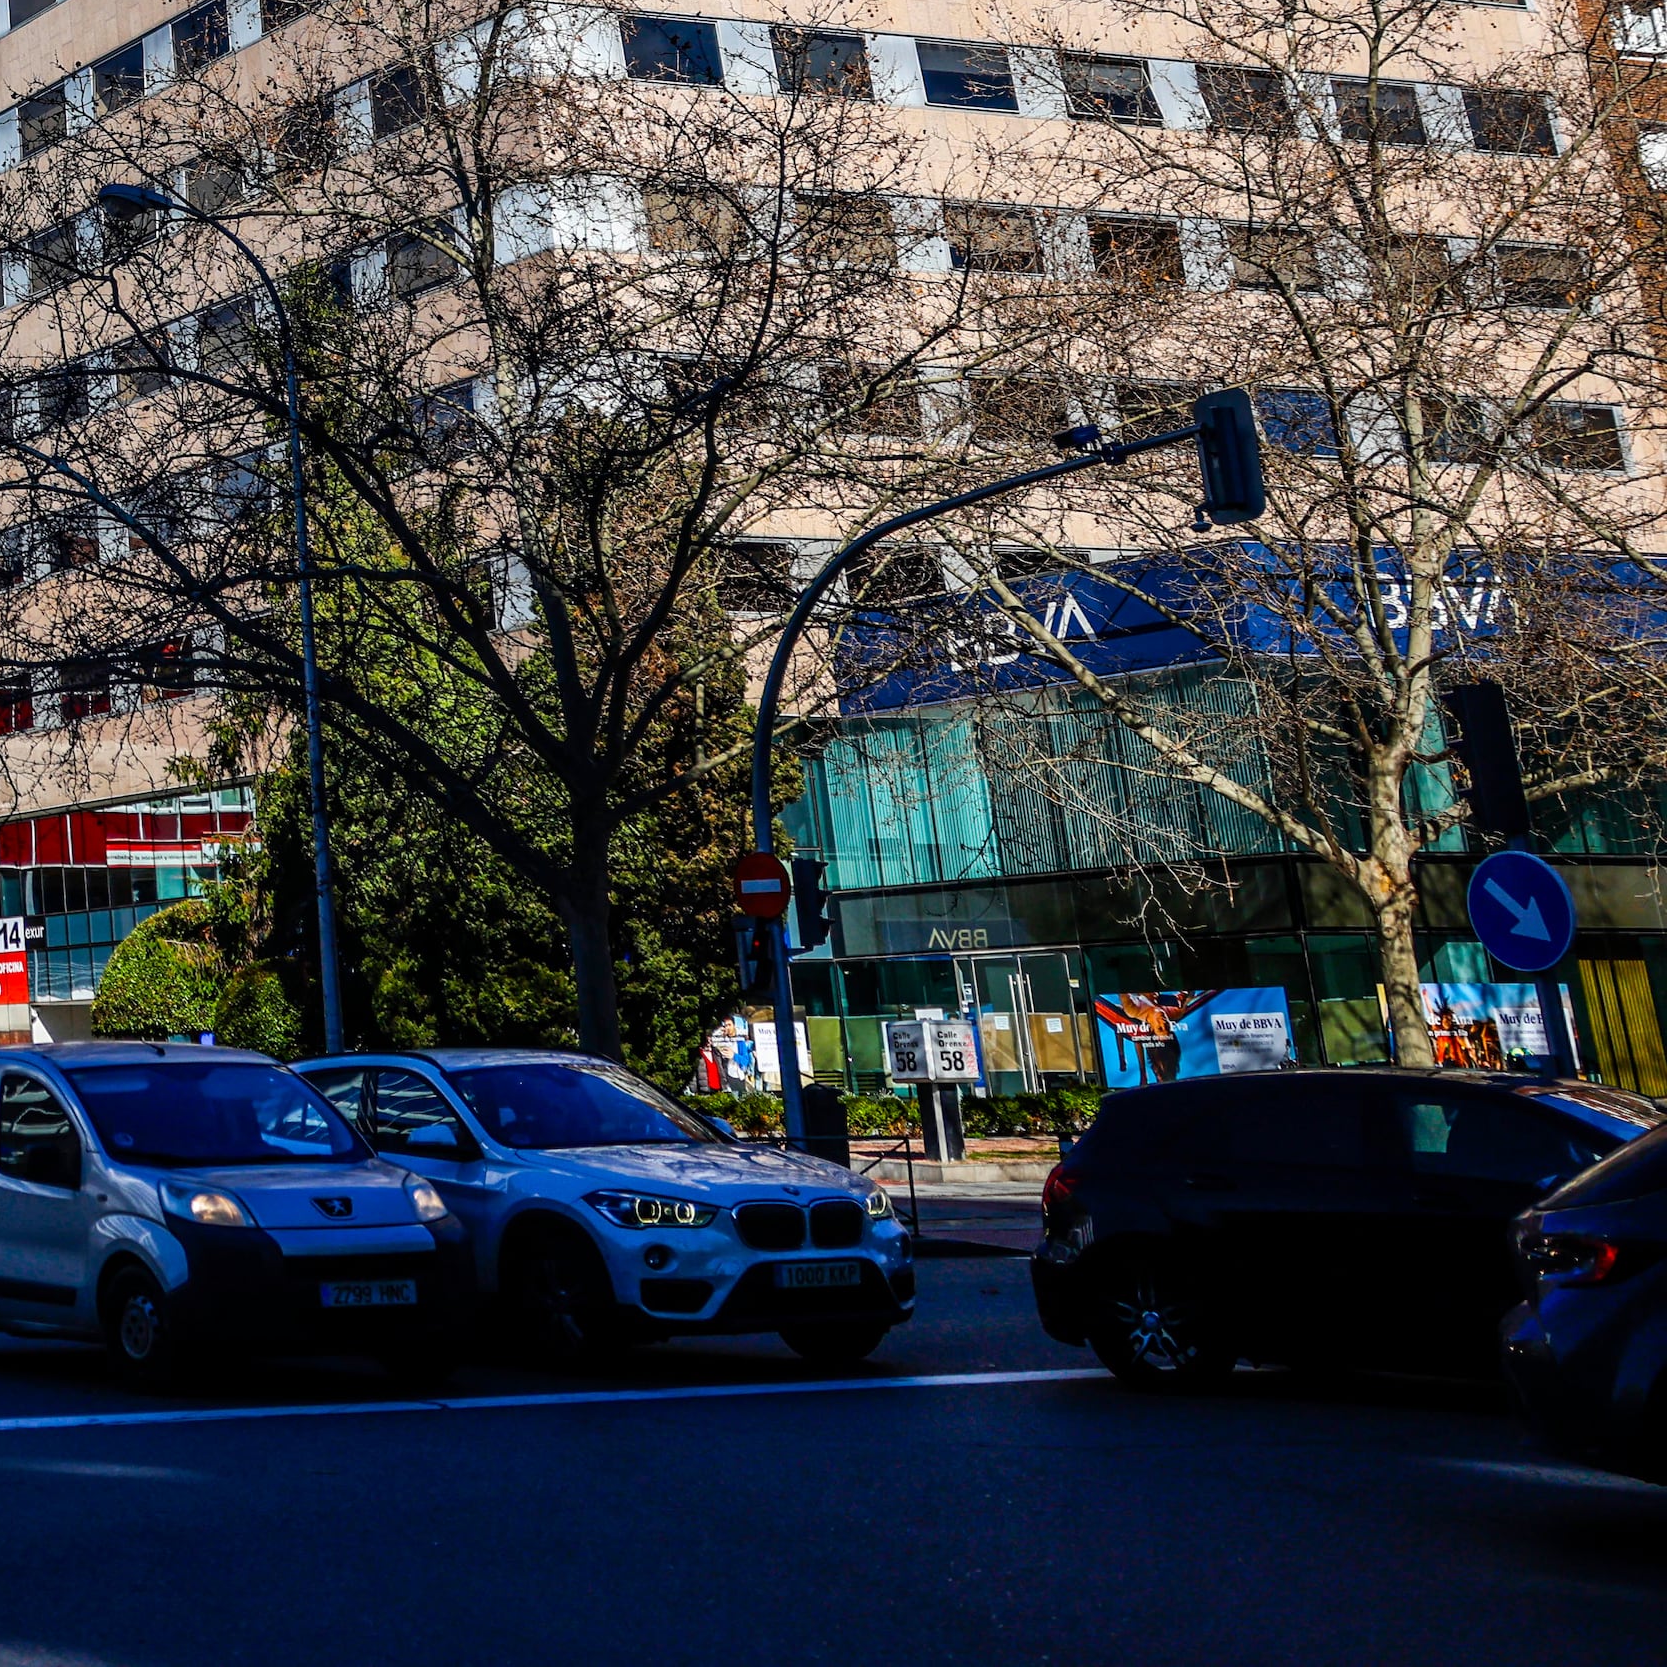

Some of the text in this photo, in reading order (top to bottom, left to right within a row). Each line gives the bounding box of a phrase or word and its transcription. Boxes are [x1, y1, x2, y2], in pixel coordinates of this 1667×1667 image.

[1216, 1017, 1283, 1032] Muy de BBVA
[1499, 1013, 1522, 1027] Muy
[1523, 1013, 1536, 1024] de
[937, 1031, 958, 1039] Calle
[1116, 1022, 1138, 1035] Muy
[893, 1032, 911, 1040] Calle
[938, 1040, 968, 1048] Orense
[895, 1051, 917, 1072] 58
[940, 1051, 965, 1071] 58
